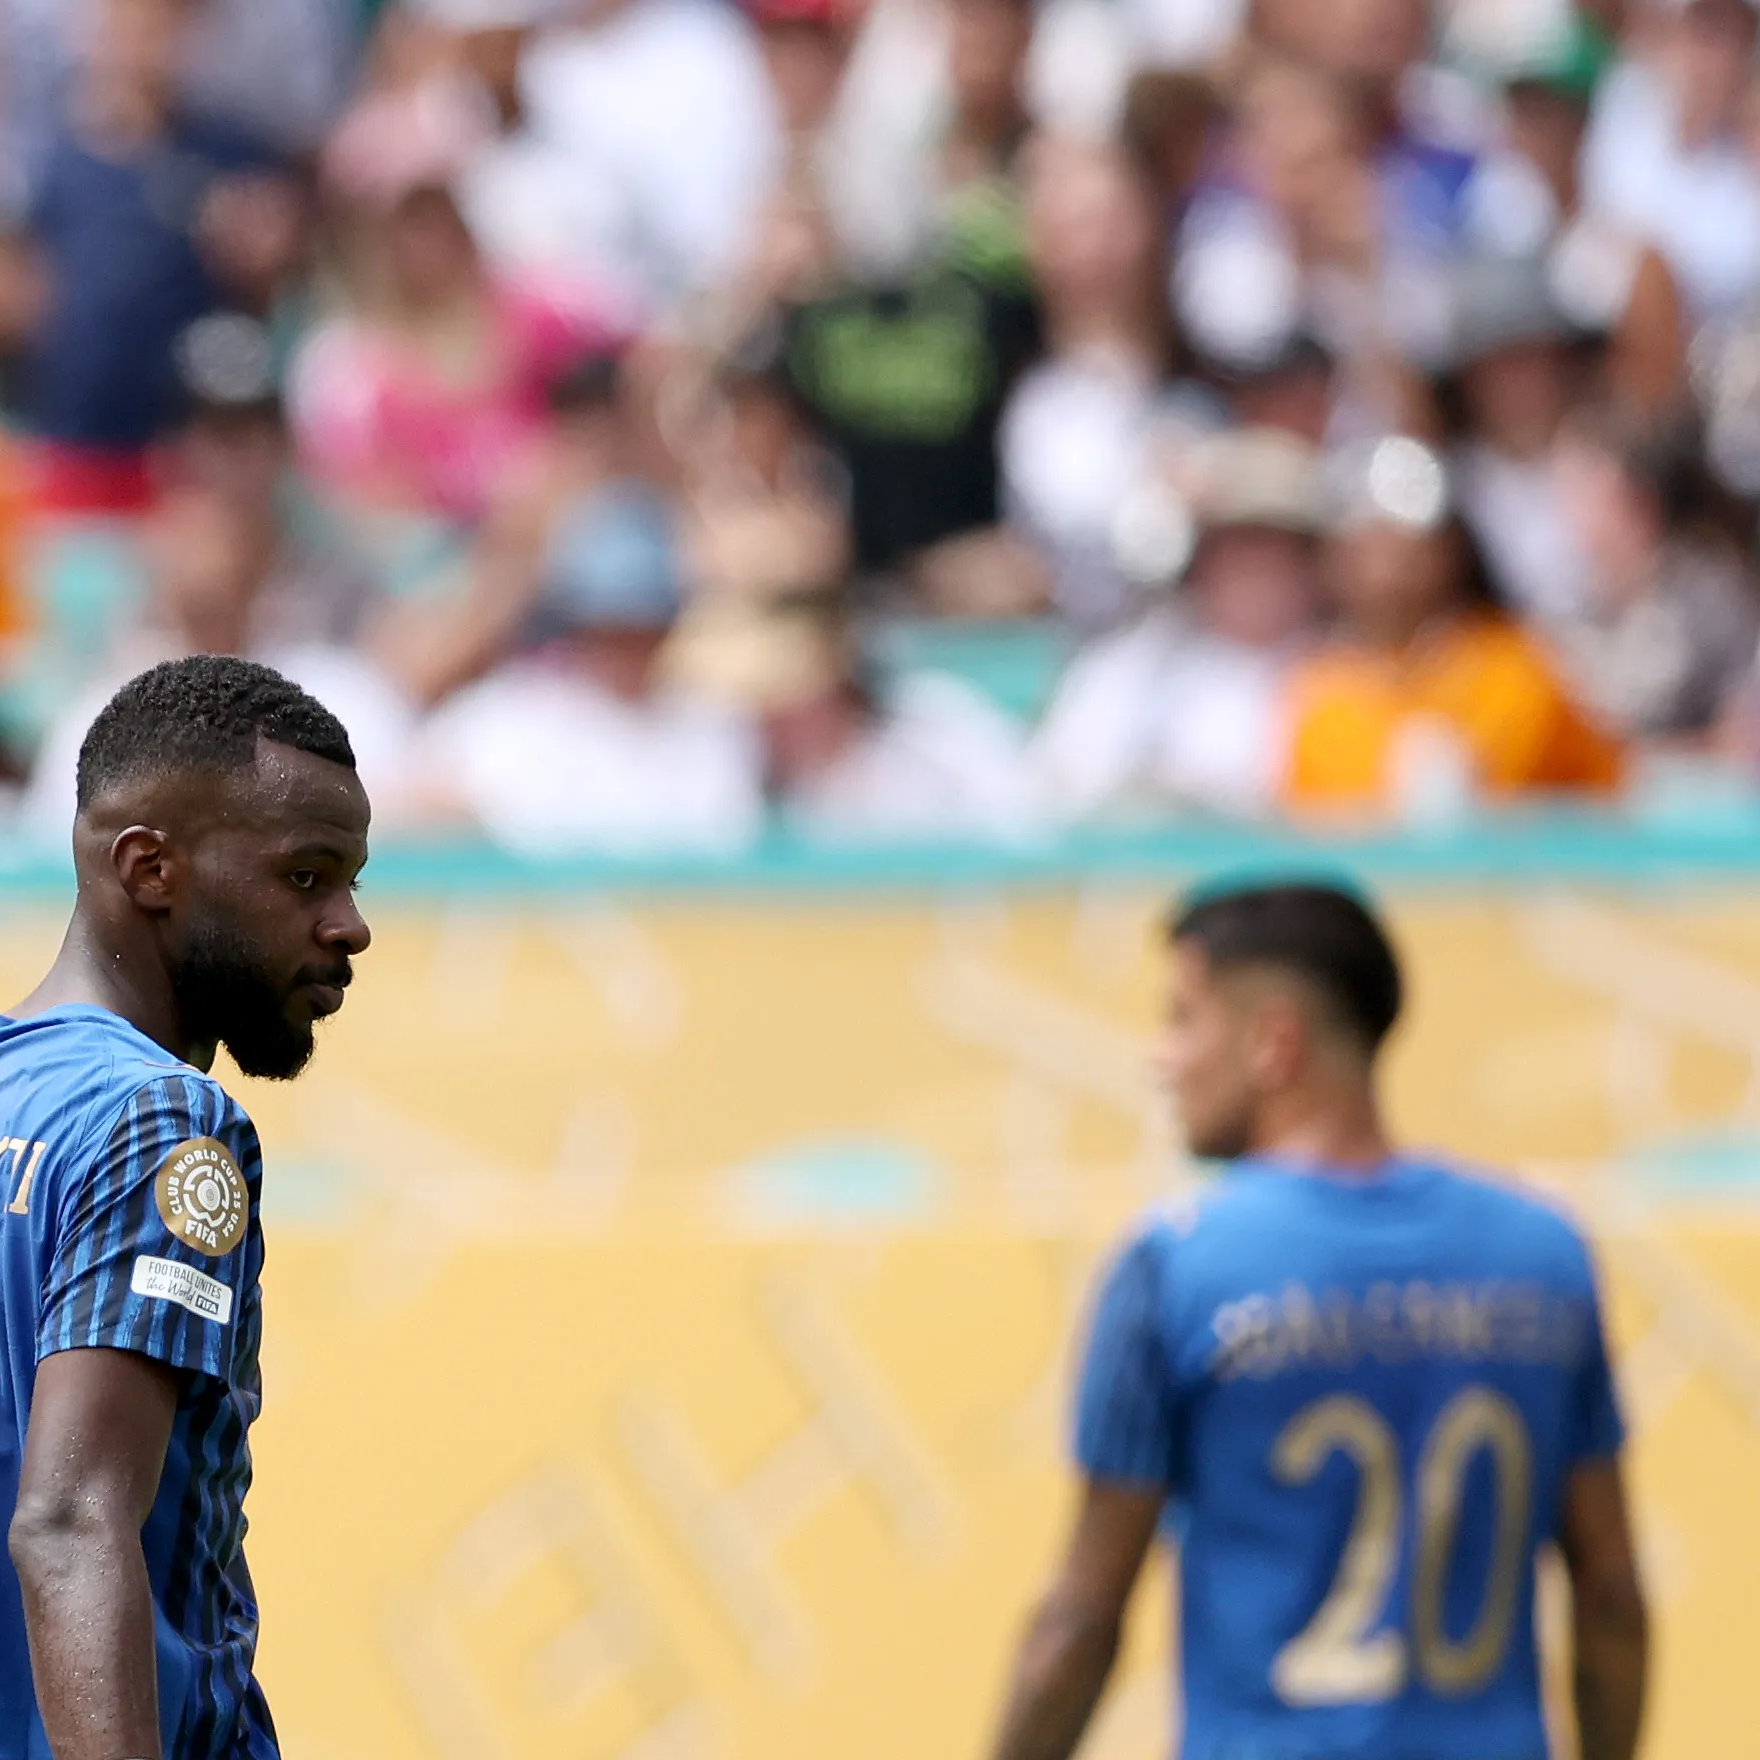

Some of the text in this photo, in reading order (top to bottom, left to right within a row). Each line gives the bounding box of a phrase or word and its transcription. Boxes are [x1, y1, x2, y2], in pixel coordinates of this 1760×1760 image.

[167, 1148, 242, 1238] CLUB WORLD CUP 25 USA
[184, 1219, 217, 1248] FIFA
[146, 1276, 218, 1314] the World FIFA
[148, 1261, 223, 1300] FOOTBALL UNITES
[1269, 1384, 1534, 1706] 20
